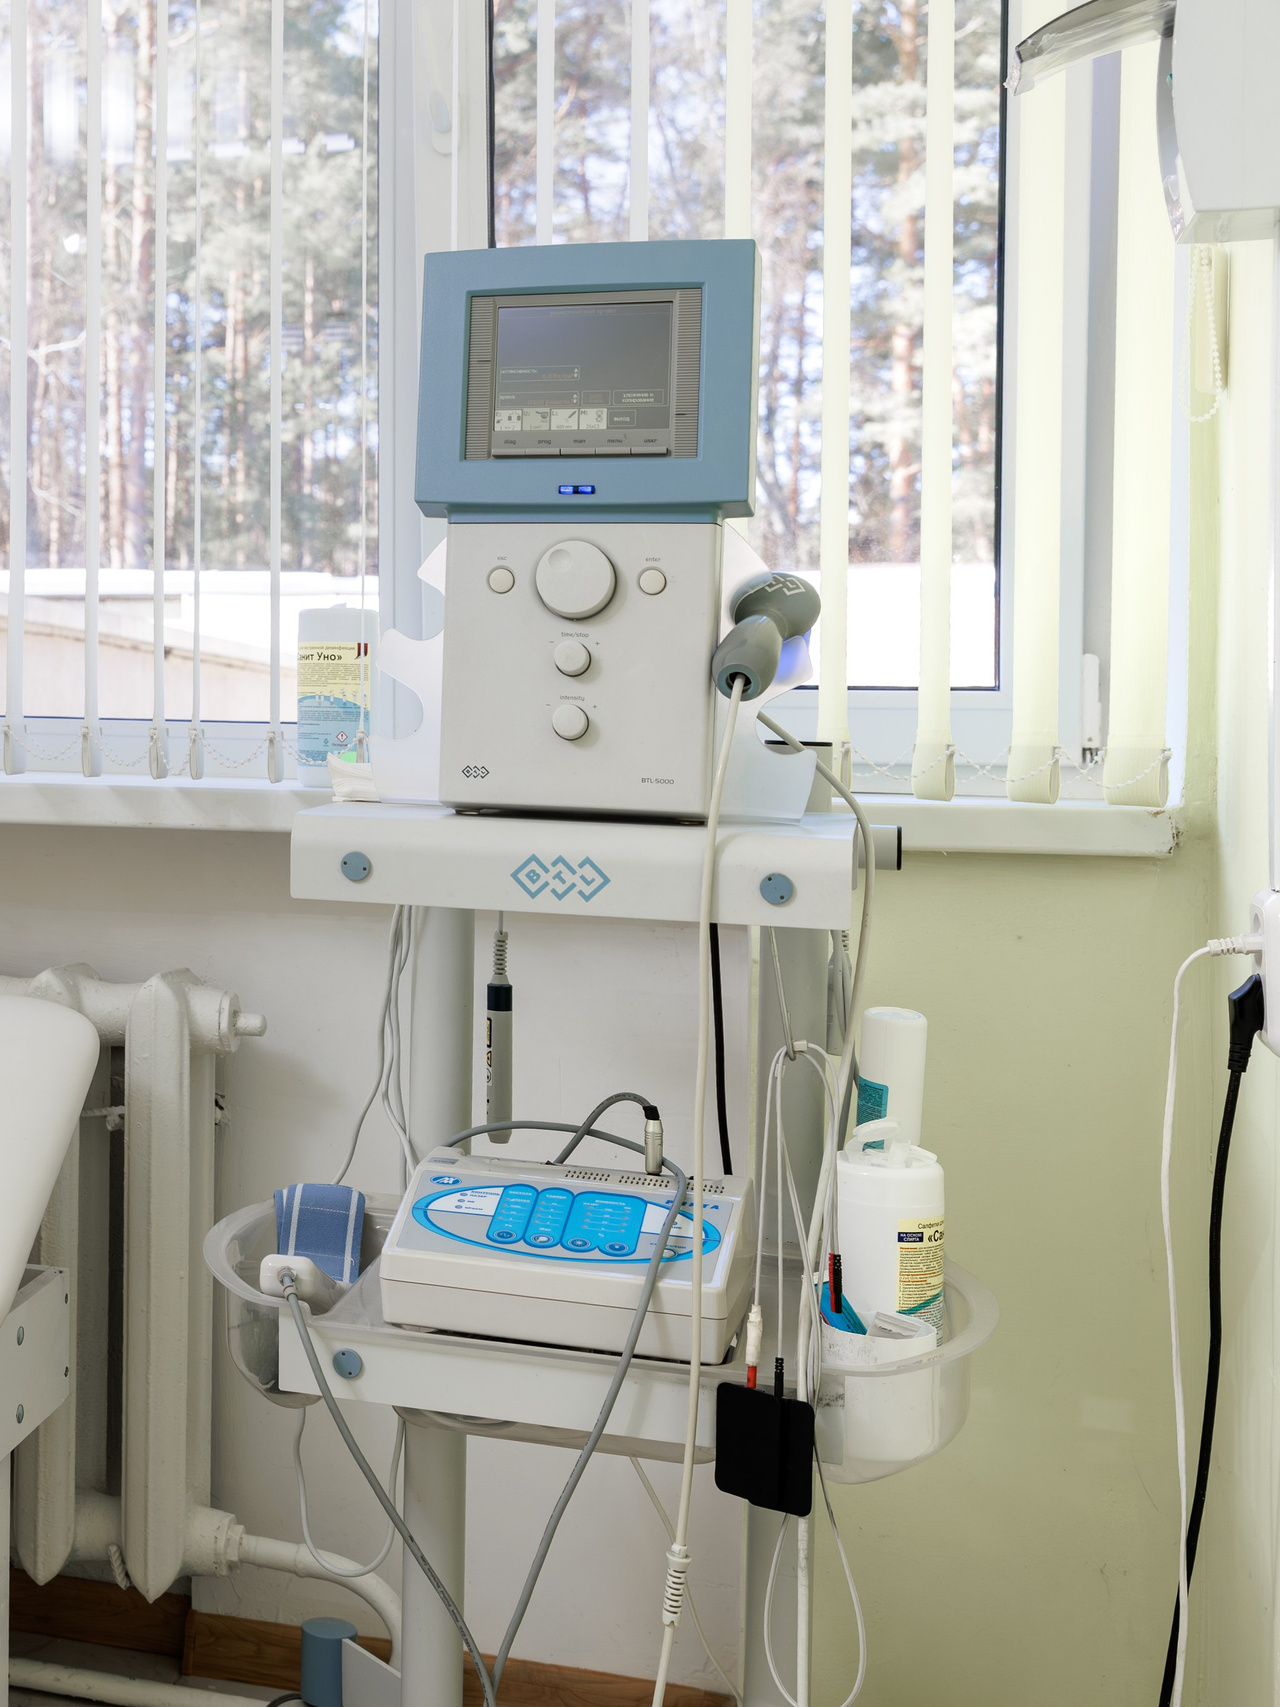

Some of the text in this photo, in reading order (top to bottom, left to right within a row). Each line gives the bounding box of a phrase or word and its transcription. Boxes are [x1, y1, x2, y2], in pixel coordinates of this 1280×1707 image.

[537, 438, 552, 446] prog
[561, 630, 590, 639] time/stop
[560, 694, 586, 702] intensity
[641, 777, 675, 785] BTL-5000
[917, 1221, 940, 1230] Салфетки
